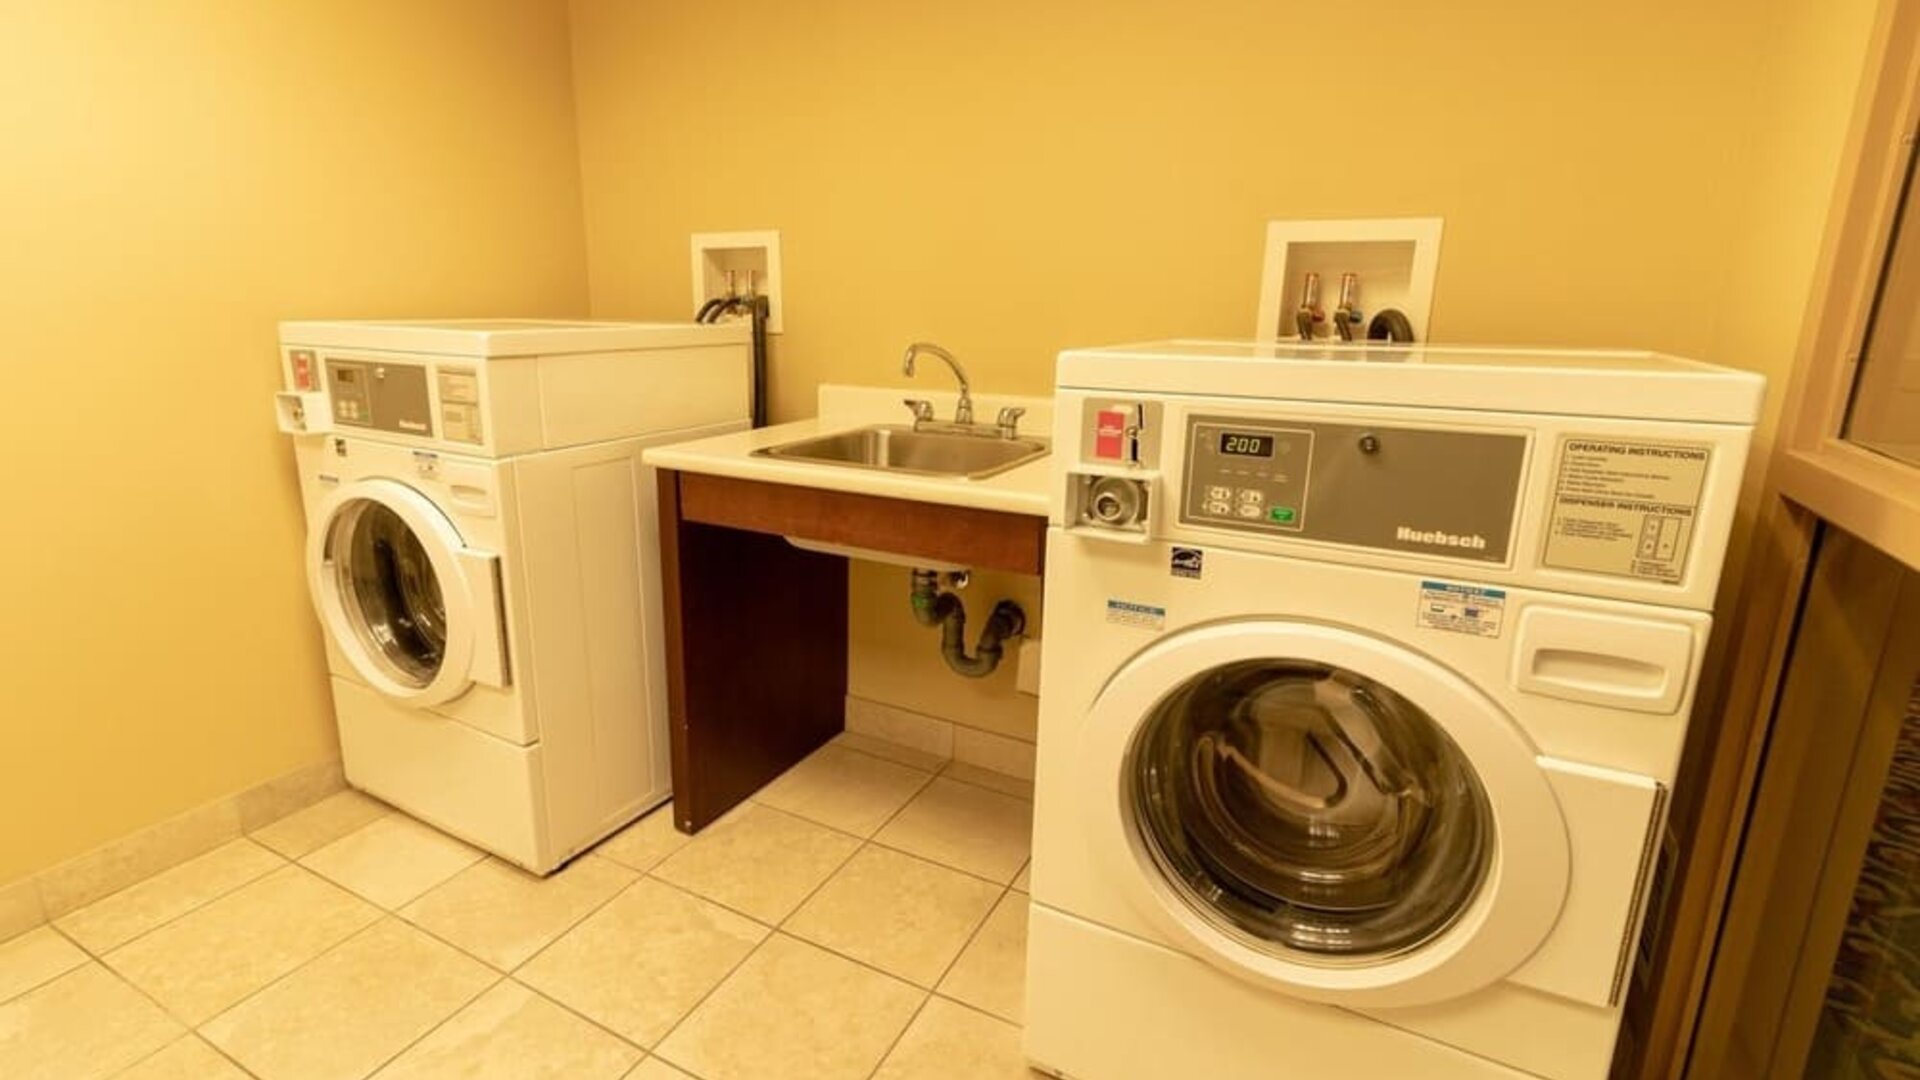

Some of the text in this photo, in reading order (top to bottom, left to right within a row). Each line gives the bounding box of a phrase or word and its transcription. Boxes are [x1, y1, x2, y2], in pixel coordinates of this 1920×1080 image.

[1226, 437, 1260, 453] 200
[1568, 442, 1706, 461] OPERATING INSTRUCTIONS
[1616, 500, 1693, 517] INSTRUCTIONS
[1397, 526, 1486, 549] Huebsch
